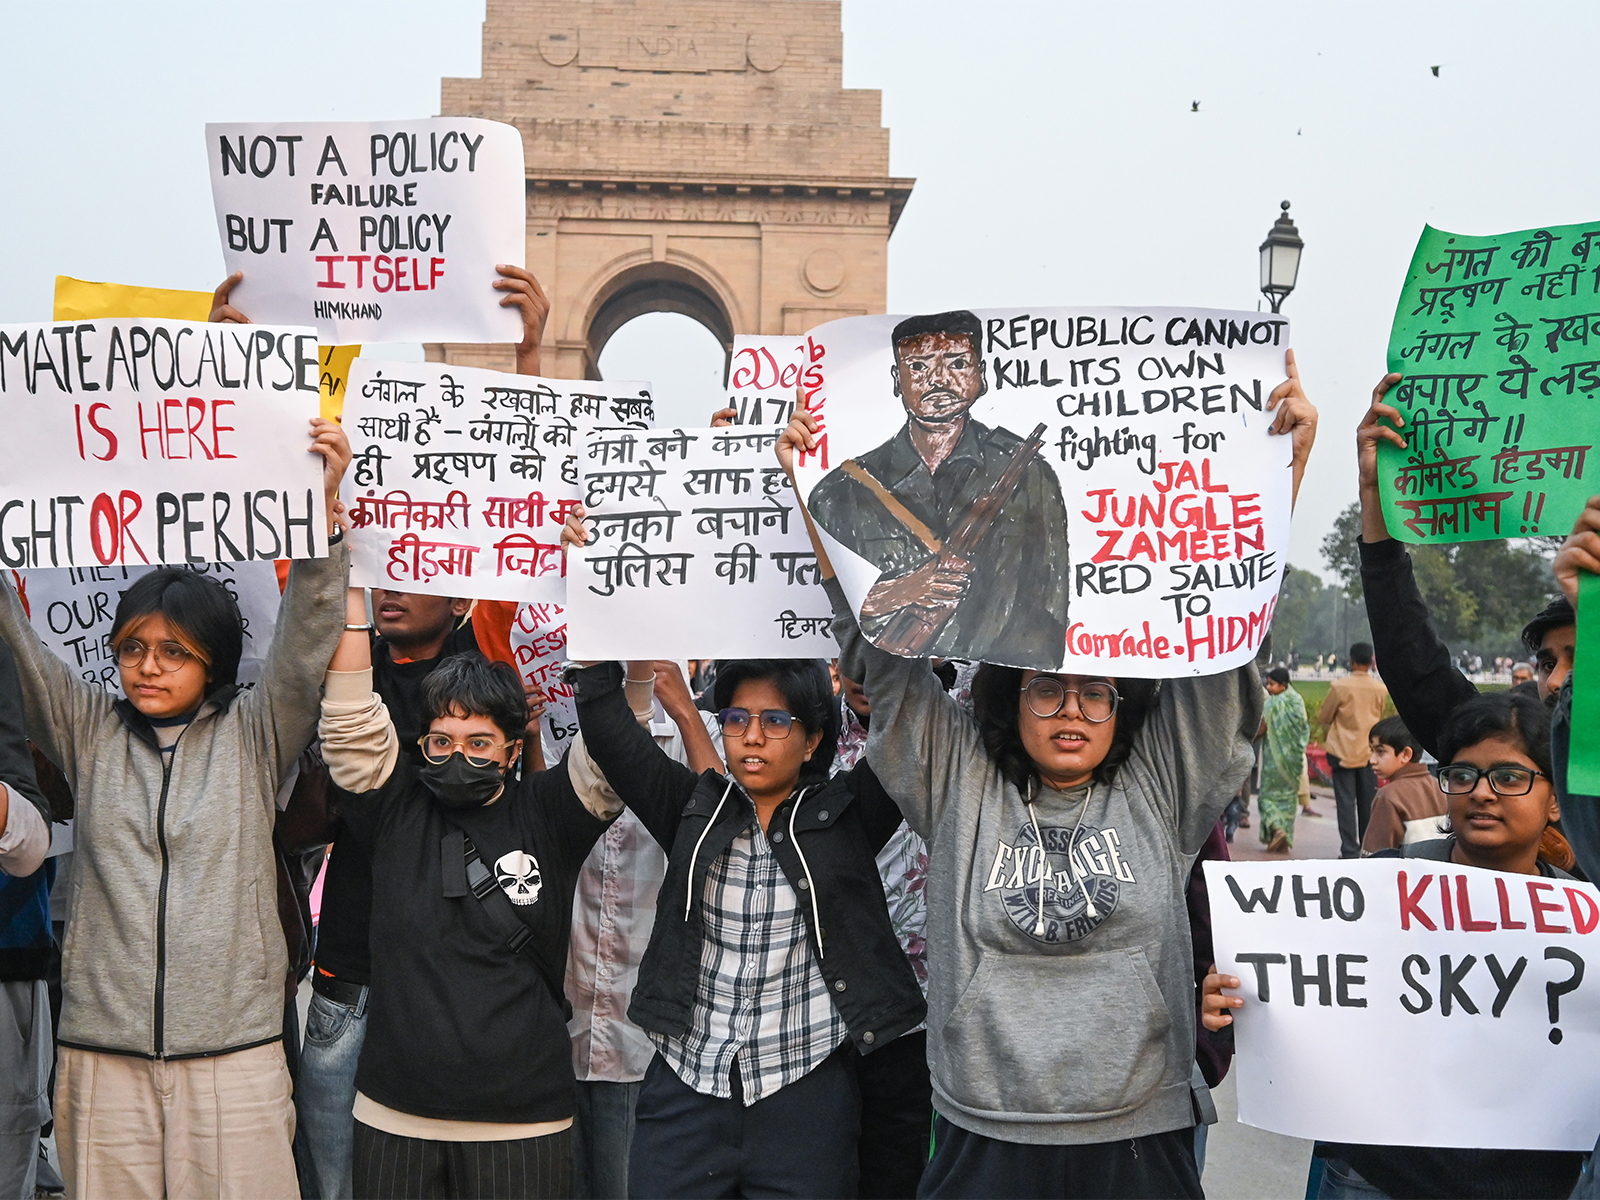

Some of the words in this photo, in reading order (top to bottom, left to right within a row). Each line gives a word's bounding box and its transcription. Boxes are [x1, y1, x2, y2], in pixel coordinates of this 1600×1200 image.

[626, 36, 699, 57] INDIA
[219, 135, 303, 178] NOT
[316, 135, 348, 177] A
[370, 131, 484, 177] POLICY
[310, 182, 418, 208] FAILURE
[226, 214, 294, 254] BUT
[309, 217, 339, 252] A
[360, 213, 452, 254] POLICY
[1510, 230, 1562, 269] को
[1571, 230, 1600, 263] ब
[315, 255, 445, 293] ITSELF
[314, 300, 382, 321] HIMKHAND
[986, 314, 1155, 353] REPUBLIC
[1165, 316, 1288, 348] CANNOT
[1492, 311, 1533, 353] के
[0, 324, 101, 394] MATE
[106, 326, 319, 394] APOCALYPSE
[994, 357, 1063, 389] KILL
[1069, 356, 1121, 387] ITS
[1137, 350, 1226, 383] OWN
[362, 370, 427, 404] जंगल
[439, 374, 465, 409] के
[480, 383, 562, 415] रखवाले
[569, 393, 607, 420] हम
[1056, 379, 1263, 417] CHILDREN
[1396, 373, 1489, 411] बचाए
[1496, 354, 1539, 399] ये
[75, 402, 118, 461] IS
[138, 397, 238, 461] HERE
[357, 412, 412, 443] साथी
[543, 416, 578, 447] को
[587, 434, 638, 466] मंत्री
[646, 429, 698, 461] बने
[1054, 425, 1156, 475] fighting
[1172, 422, 1226, 453] for
[353, 445, 392, 486] ही
[509, 446, 547, 482] को
[584, 460, 666, 508] हमसे
[683, 468, 755, 495] साफ
[1152, 458, 1229, 493] JAL
[0, 496, 84, 568] GHT
[90, 490, 150, 566] OR
[156, 489, 315, 565] PERISH
[348, 489, 471, 530] क्रांतिकारी
[482, 491, 550, 529] साथी
[581, 496, 681, 546] उनको
[692, 496, 793, 539] बचाने
[1081, 488, 1263, 531] JUNGLE
[1395, 491, 1513, 538] सलाम
[1091, 525, 1265, 563] ZAMEEN
[585, 542, 695, 597] पुलिस
[714, 543, 762, 585] की
[1076, 562, 1153, 596] RED
[1170, 551, 1277, 591] SALUTE
[47, 591, 114, 634] OUR
[1161, 593, 1211, 623] TO
[1225, 874, 1366, 922] WHO
[1398, 870, 1600, 935] KILLED
[1235, 952, 1368, 1008] THE
[1400, 946, 1585, 1045] SKY?
